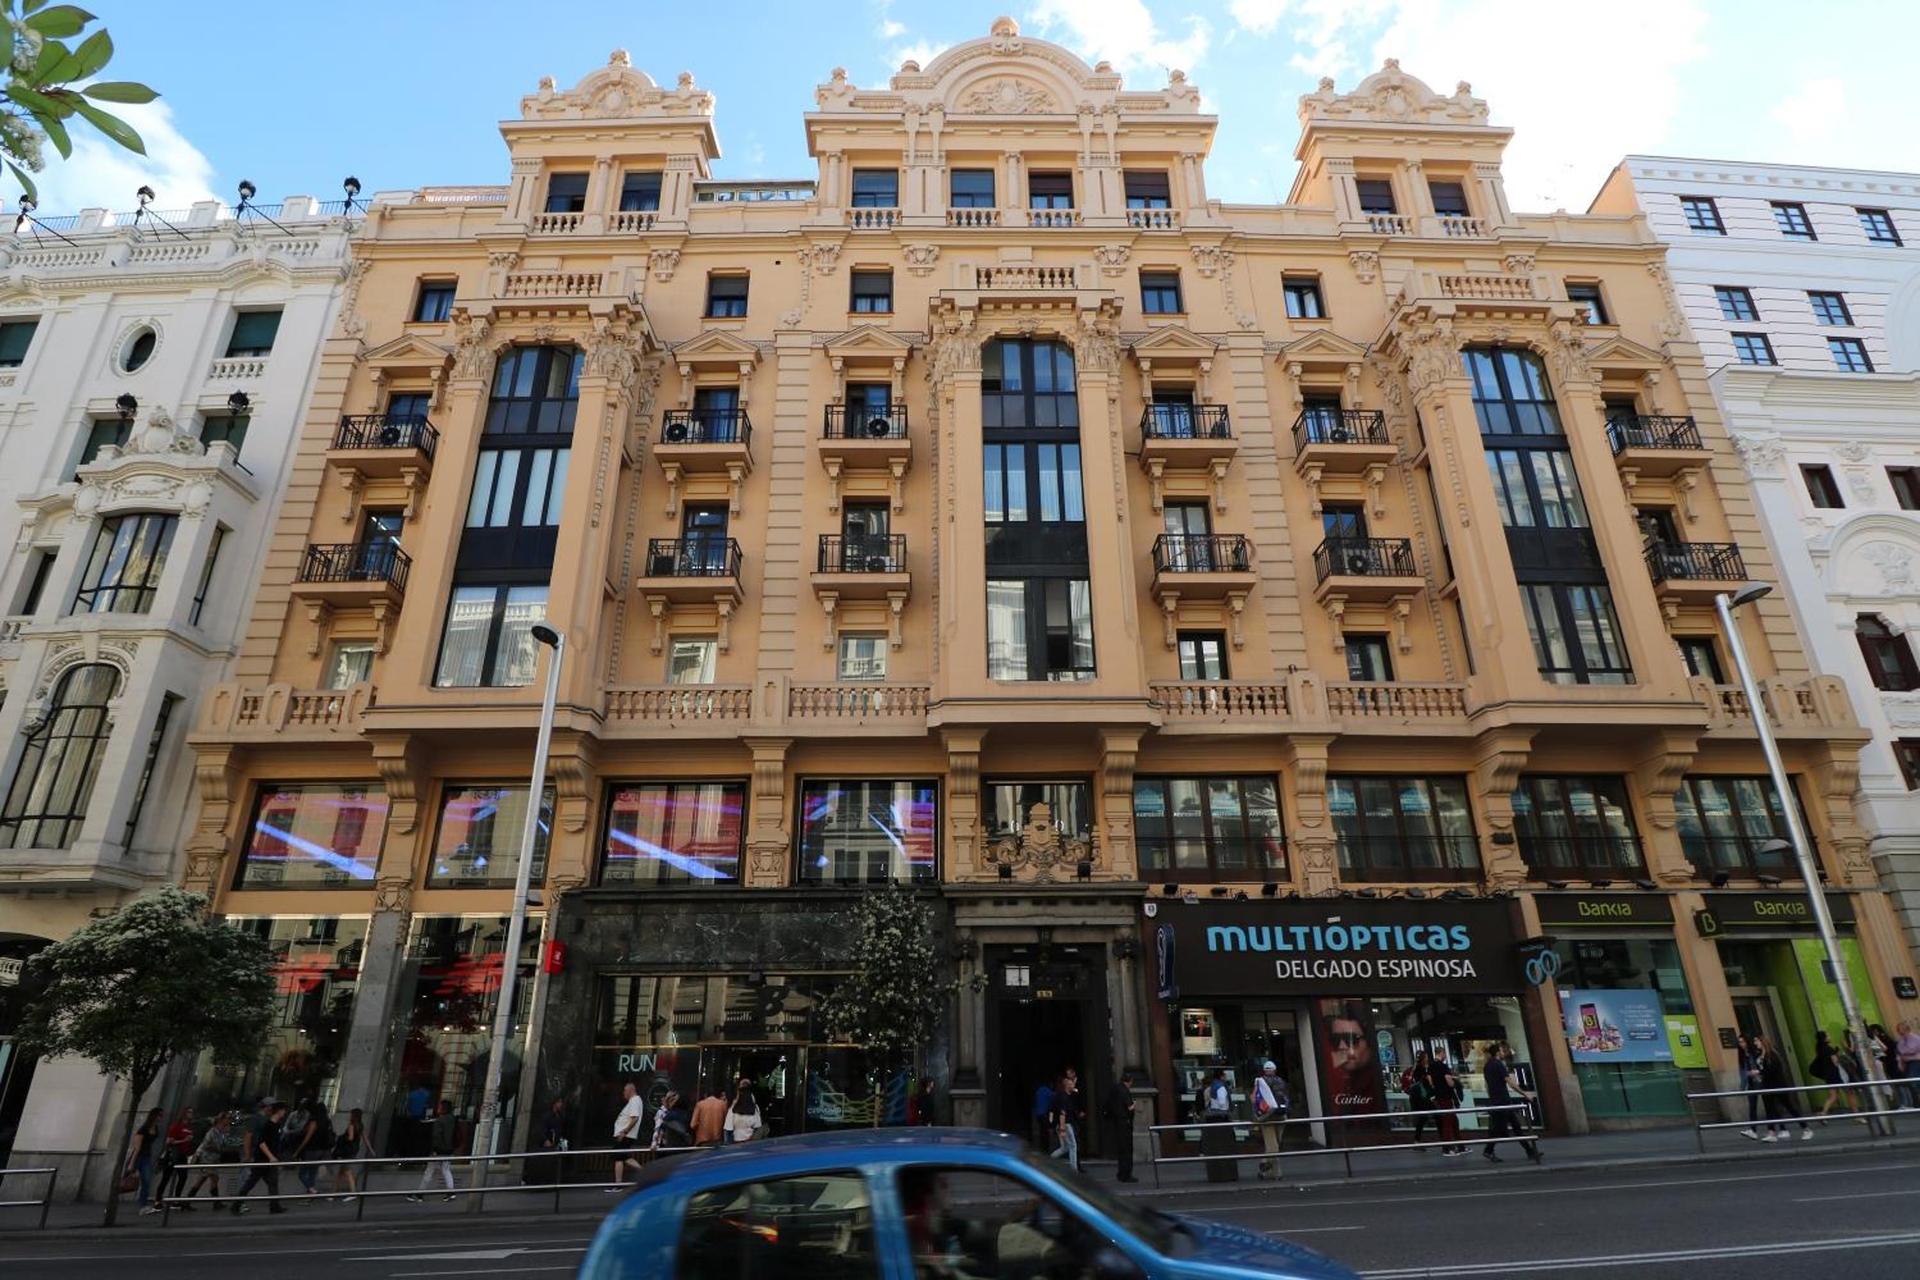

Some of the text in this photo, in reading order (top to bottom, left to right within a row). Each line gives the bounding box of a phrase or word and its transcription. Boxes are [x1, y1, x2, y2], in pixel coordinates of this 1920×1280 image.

[1578, 901, 1632, 916] Bankia
[1754, 900, 1806, 915] Bankia
[1702, 912, 1717, 934] B
[1276, 959, 1477, 979] DELGADO ESPINOSA
[618, 1054, 657, 1073] RUN
[1334, 1093, 1373, 1106] Cartier
